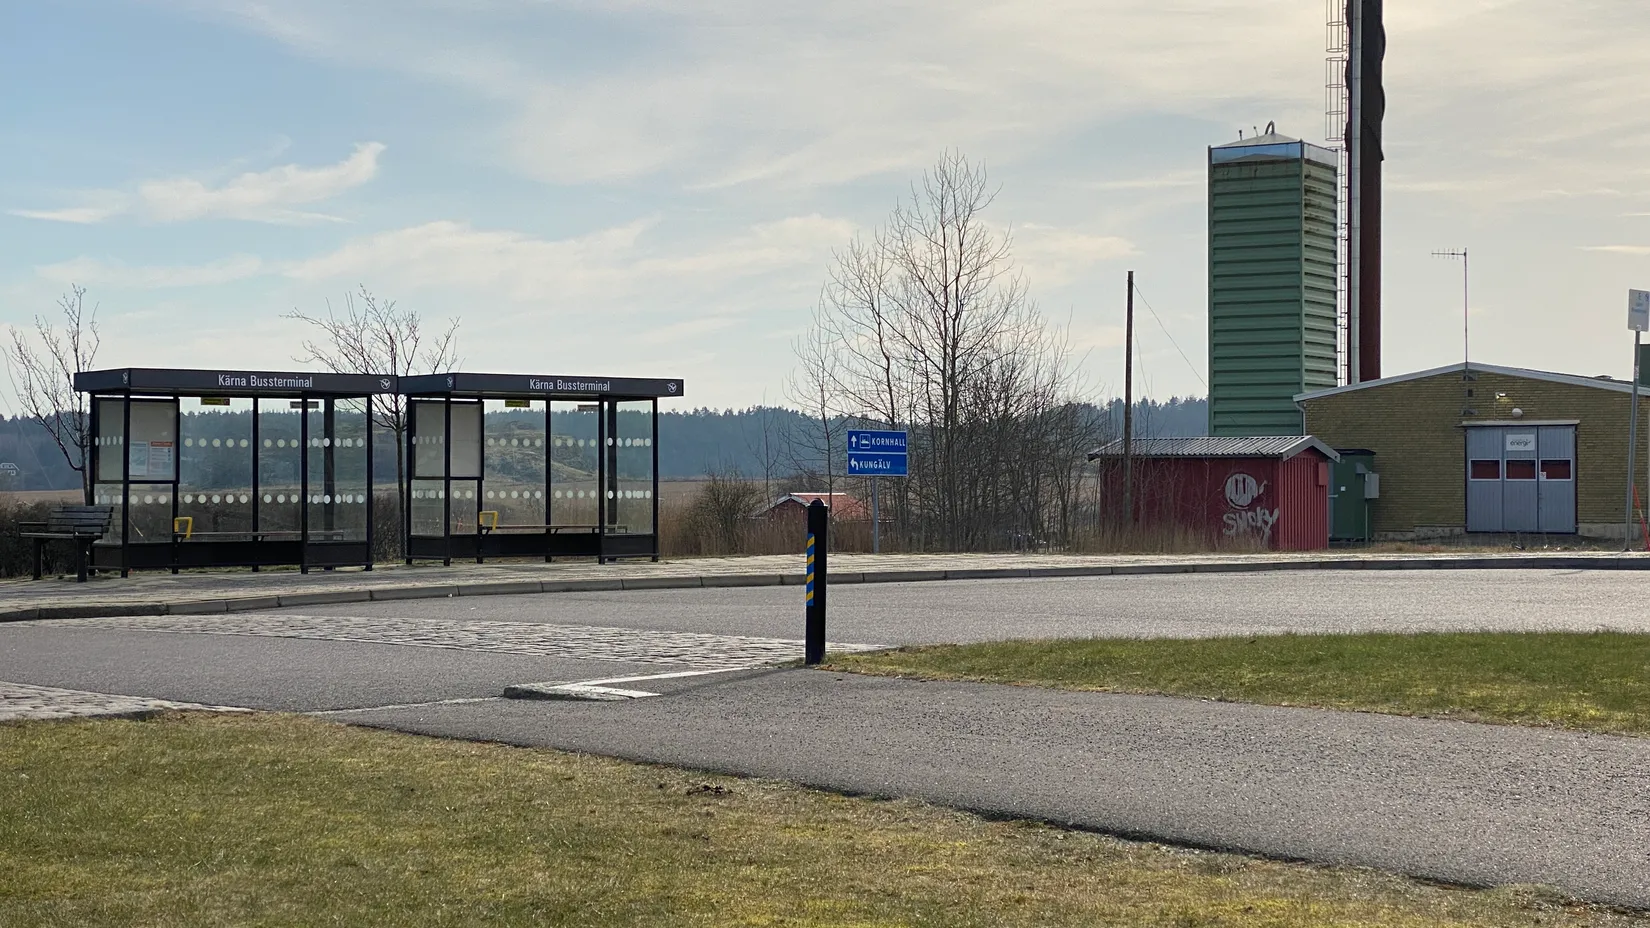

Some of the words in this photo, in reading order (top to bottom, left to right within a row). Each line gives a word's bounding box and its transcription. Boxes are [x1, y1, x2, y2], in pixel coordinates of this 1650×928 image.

[218, 374, 246, 387] Kärna
[250, 375, 313, 388] Bussterminal
[529, 378, 554, 390] Kärna
[557, 379, 610, 392] Bussterminal
[871, 437, 906, 447] KORNHALL
[859, 458, 891, 469] KUNGÄLV
